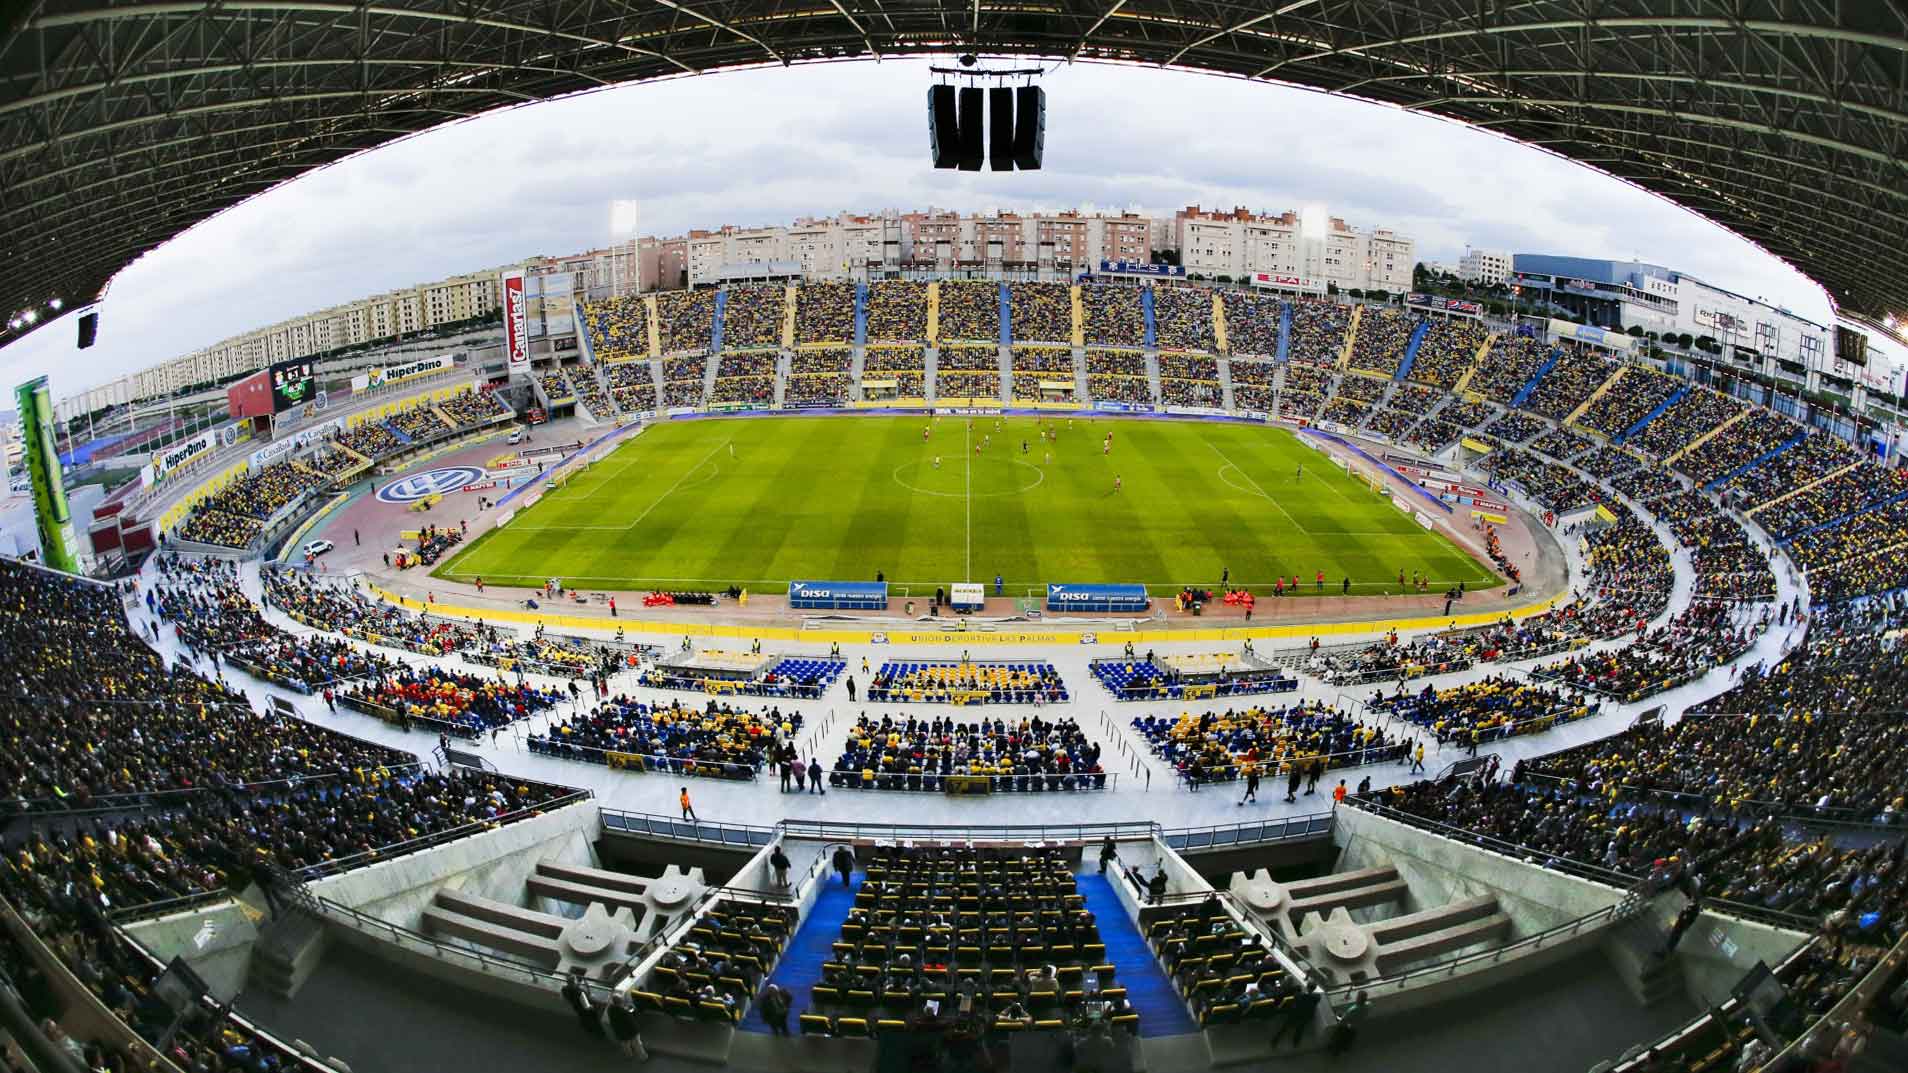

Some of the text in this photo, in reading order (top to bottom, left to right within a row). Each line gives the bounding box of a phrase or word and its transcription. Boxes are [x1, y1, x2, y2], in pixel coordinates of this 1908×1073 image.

[509, 287, 526, 361] Canarias7
[386, 360, 442, 380] HiperDino
[165, 439, 207, 470] HiperDino
